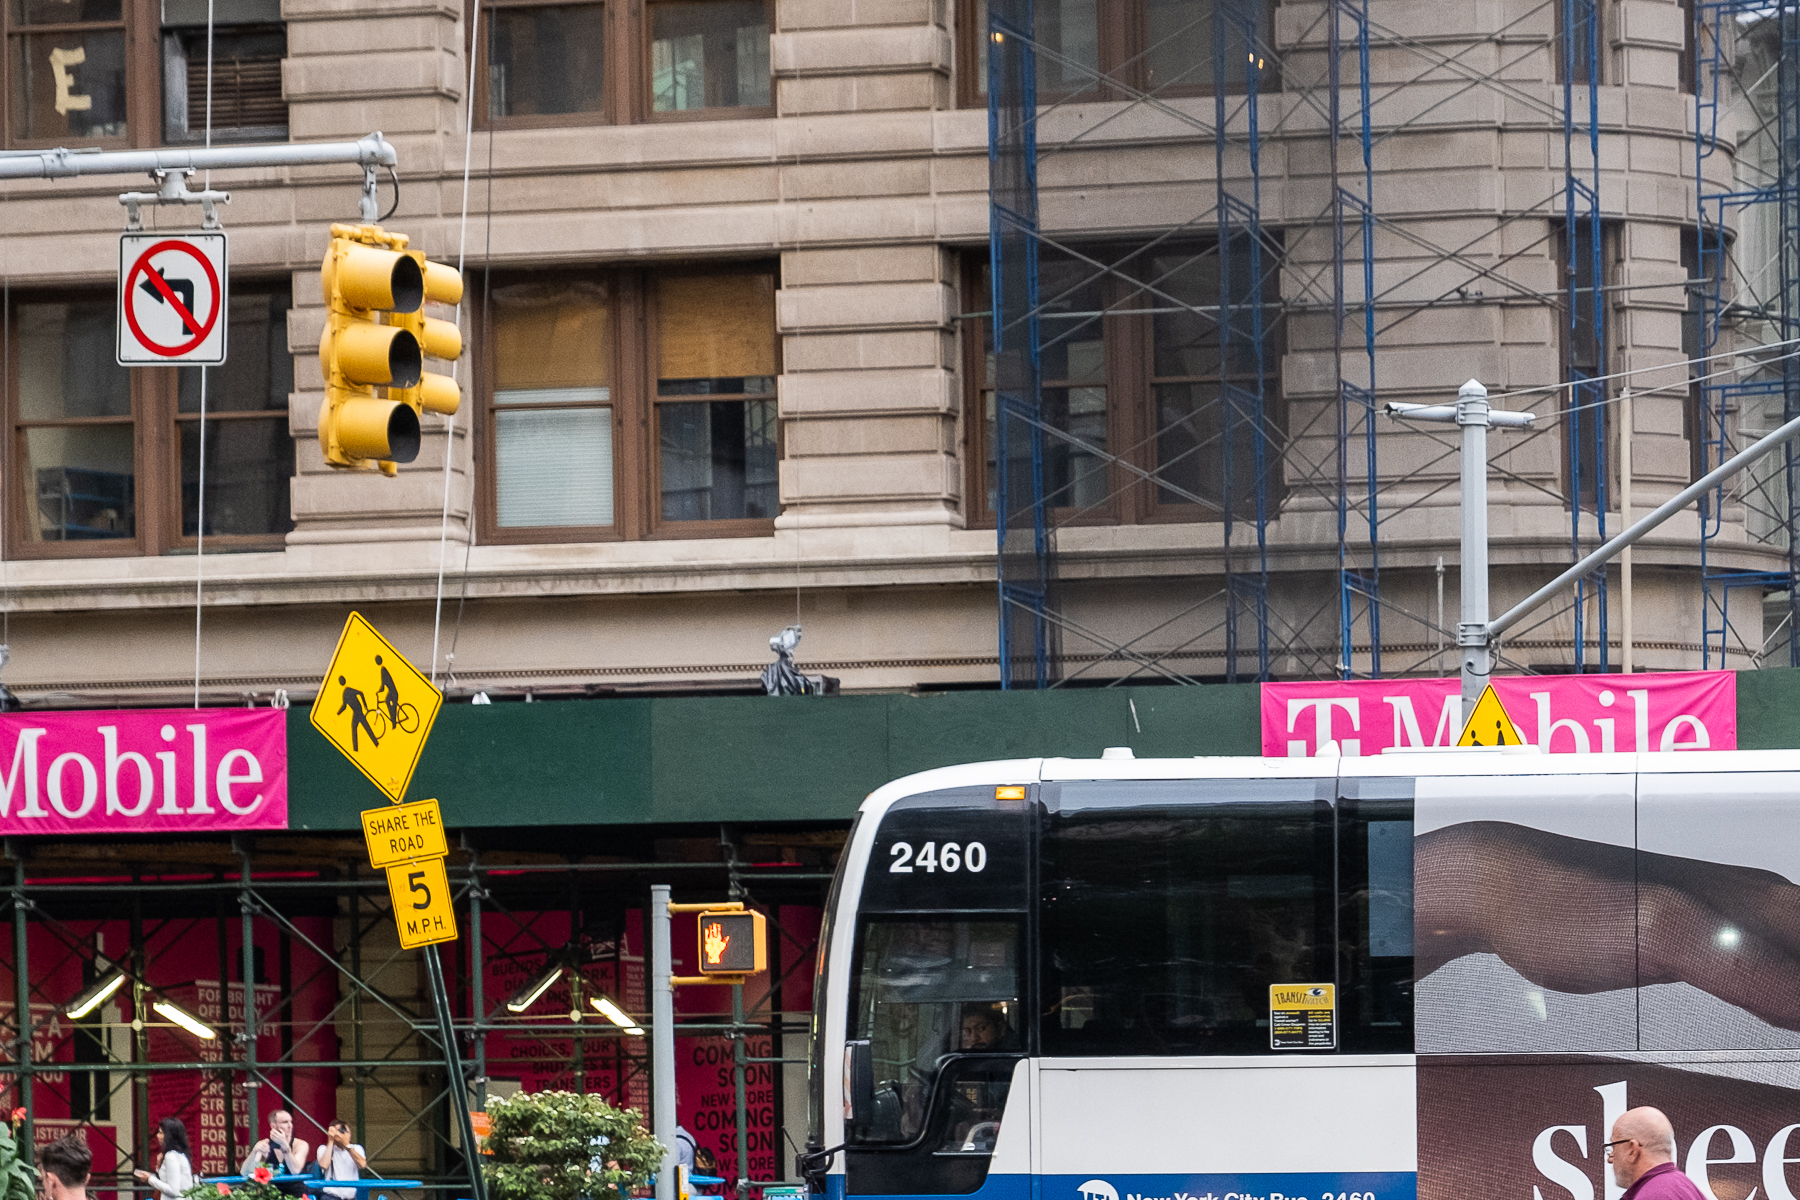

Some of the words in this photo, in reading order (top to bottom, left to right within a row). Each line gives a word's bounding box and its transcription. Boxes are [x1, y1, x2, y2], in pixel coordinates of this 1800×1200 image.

[49, 46, 93, 117] E
[1382, 688, 1711, 754] Mbile
[369, 815, 410, 836] SHARE
[413, 810, 436, 826] THE
[389, 834, 424, 854] ROAD
[889, 841, 987, 873] 2460
[407, 870, 432, 910] 5
[227, 990, 273, 1007] BRHT
[227, 1006, 262, 1022] DUY
[582, 1040, 609, 1054] OUR
[693, 1041, 771, 1066] COMNG
[532, 1061, 598, 1075] SHUTES
[535, 1076, 611, 1091] TRANSERS
[701, 1094, 730, 1108] NEW
[732, 1090, 773, 1105] ORE
[200, 1113, 249, 1128] BLOKE
[694, 1107, 773, 1131] COMNG
[200, 1143, 250, 1159] PARDE
[734, 1156, 774, 1171] ORE
